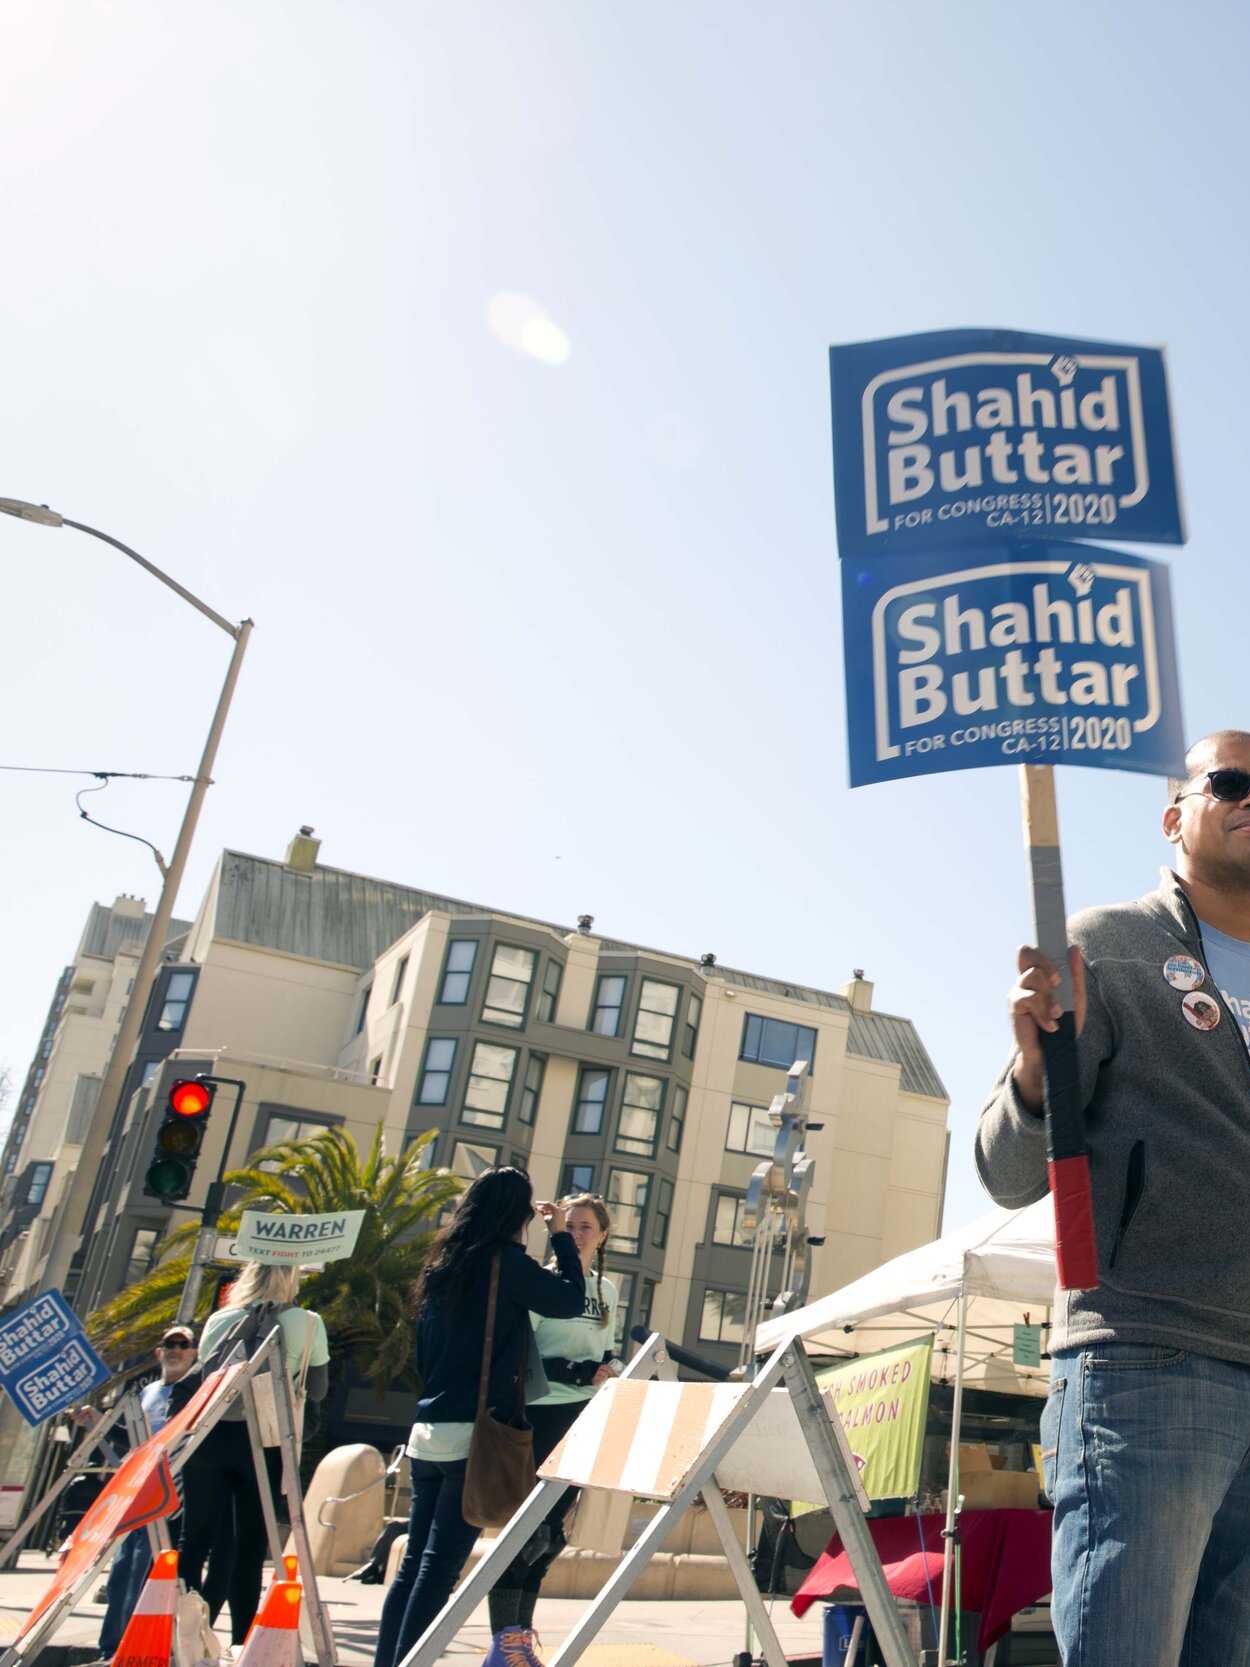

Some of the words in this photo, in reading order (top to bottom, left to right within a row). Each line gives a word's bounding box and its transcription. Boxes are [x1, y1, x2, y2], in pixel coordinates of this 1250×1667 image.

[886, 371, 1121, 446] Shahid
[888, 430, 1125, 505] Buttar
[894, 510, 934, 531] FOR
[937, 493, 1043, 521] CONGRESS
[1054, 493, 1117, 526] 2020
[985, 508, 1044, 528] CA-12
[897, 582, 1136, 665] Shahid
[898, 647, 1139, 730] Buttar
[904, 735, 946, 757] FOR
[950, 717, 1061, 746] CONGRESS
[1070, 716, 1132, 751] 2020
[1001, 735, 1062, 756] CA-12
[255, 1218, 347, 1239] WARREN
[248, 1246, 271, 1257] TEXT
[271, 1250, 300, 1258] FIGHT
[0, 1317, 60, 1367] Buttar
[23, 1348, 81, 1397] Shahid
[30, 1362, 88, 1411] Buttar
[847, 1360, 913, 1396] SMOKED
